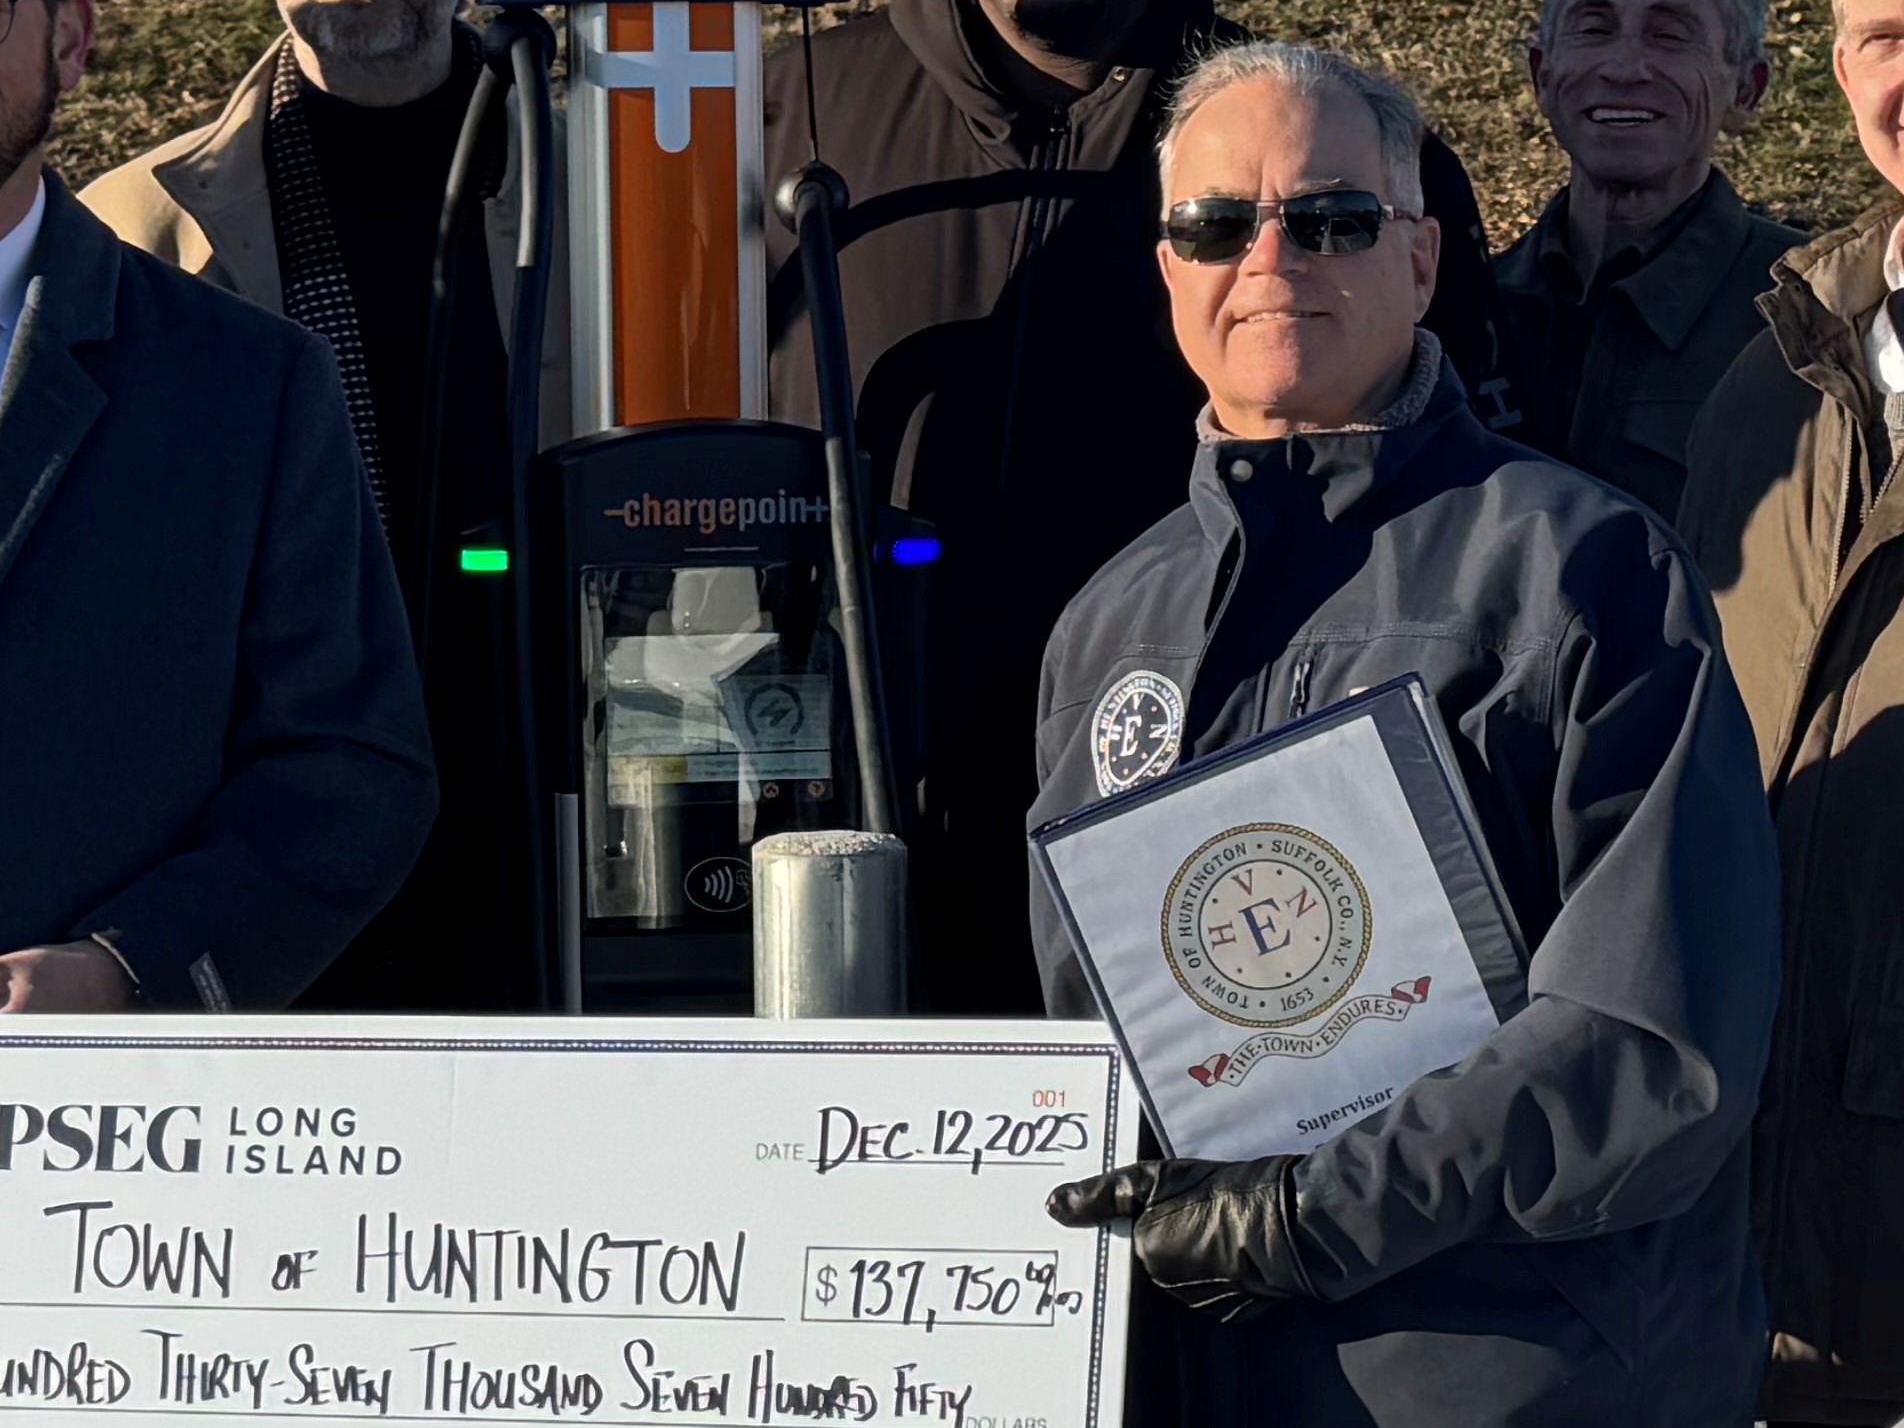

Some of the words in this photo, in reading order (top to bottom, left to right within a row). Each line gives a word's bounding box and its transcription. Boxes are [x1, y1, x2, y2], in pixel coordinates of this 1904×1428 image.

[1271, 839, 1345, 892] SUFFOLK
[1178, 842, 1247, 937] HUNTINGTON
[1183, 947, 1202, 969] OF
[1201, 975, 1250, 1010] TOWN
[1280, 988, 1315, 1012] 1653
[1229, 1045, 1258, 1075] THE
[1260, 1036, 1313, 1054] TOWN
[1321, 999, 1396, 1046] ENDURES
[1032, 1090, 1065, 1108] 001
[1296, 1086, 1394, 1136] Supervisor
[228, 1106, 357, 1137] LONG
[226, 1144, 403, 1175] ISLAND
[756, 1142, 804, 1161] DATE
[43, 1200, 233, 1298] TOWN
[355, 1210, 746, 1312] HUNTINGTON
[409, 1341, 603, 1415] THOUSAND
[621, 1338, 730, 1415] SEVEN
